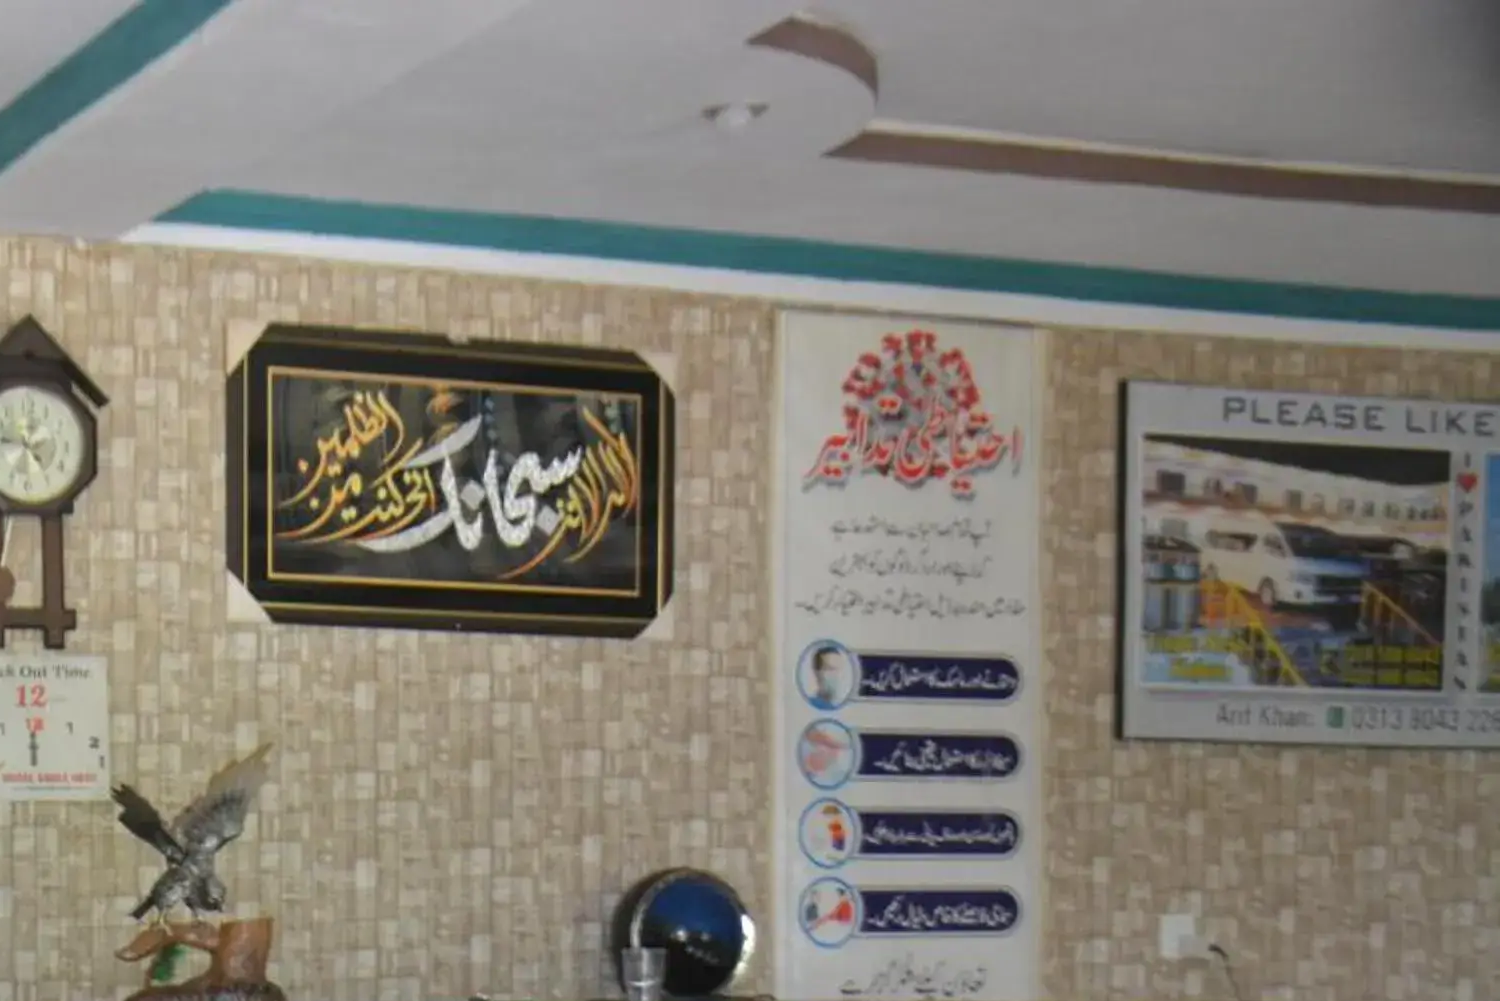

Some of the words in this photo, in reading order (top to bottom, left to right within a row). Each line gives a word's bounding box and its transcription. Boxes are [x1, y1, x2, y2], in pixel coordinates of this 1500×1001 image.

[1222, 396, 1386, 432] PLEASE
[1406, 406, 1496, 438] LIKE
[19, 667, 47, 679] Out
[16, 684, 47, 707] 12
